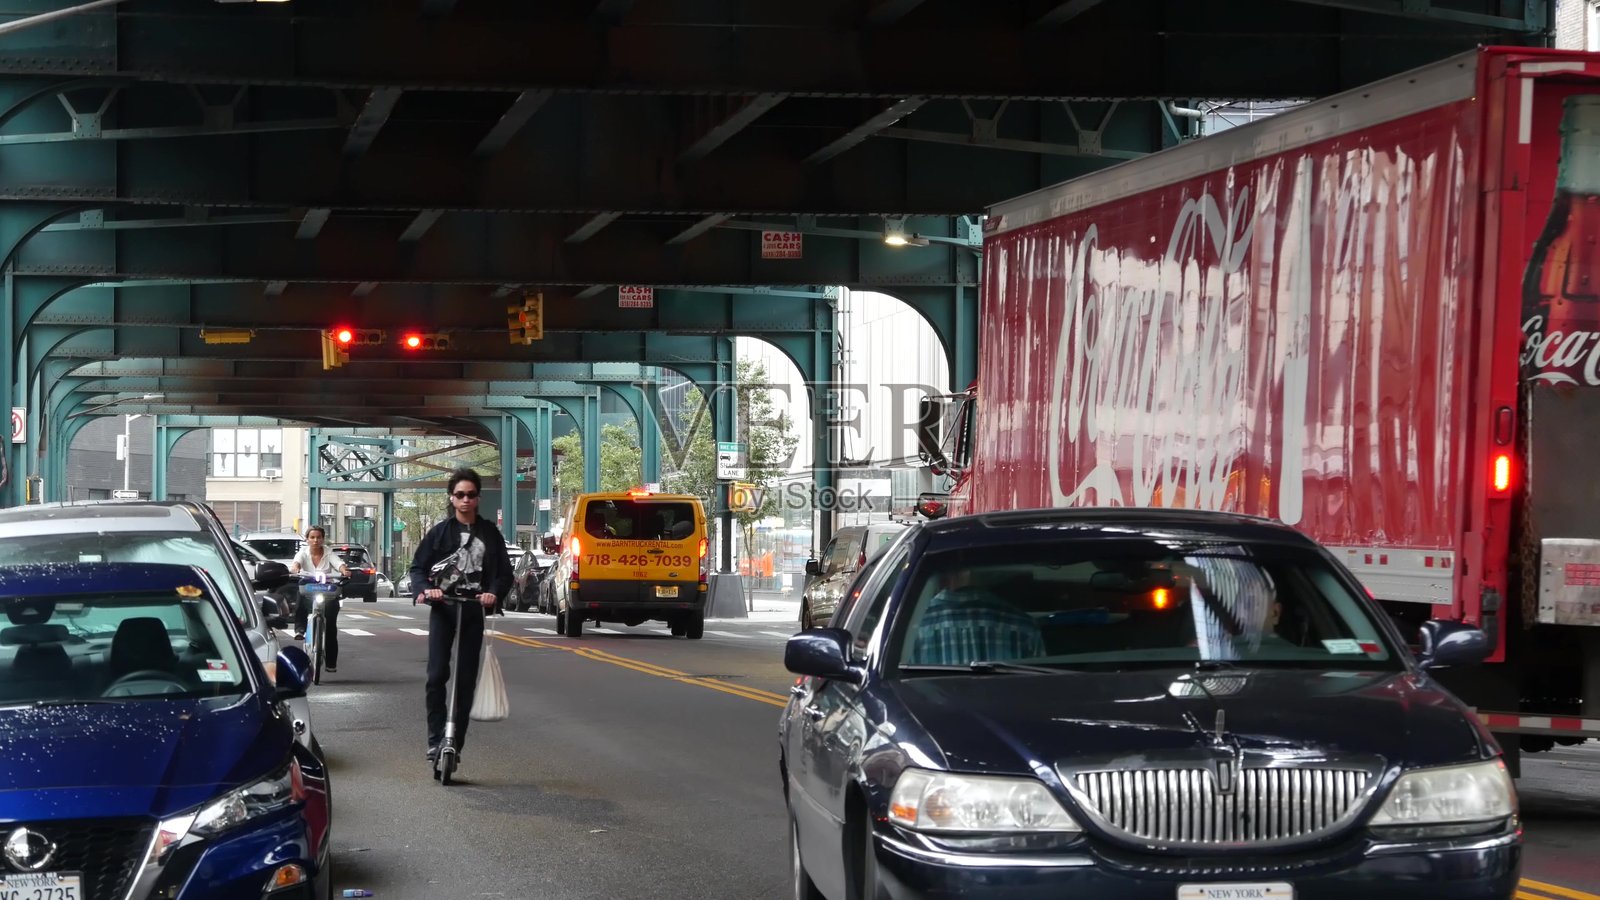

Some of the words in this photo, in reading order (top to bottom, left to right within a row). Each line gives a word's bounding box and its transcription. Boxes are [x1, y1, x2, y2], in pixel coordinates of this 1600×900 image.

[588, 554, 692, 567] 718-426-7039
[7, 880, 28, 888] NEW
[31, 878, 58, 887] YORK
[1208, 889, 1232, 898] NEW
[1236, 888, 1264, 898] YORK
